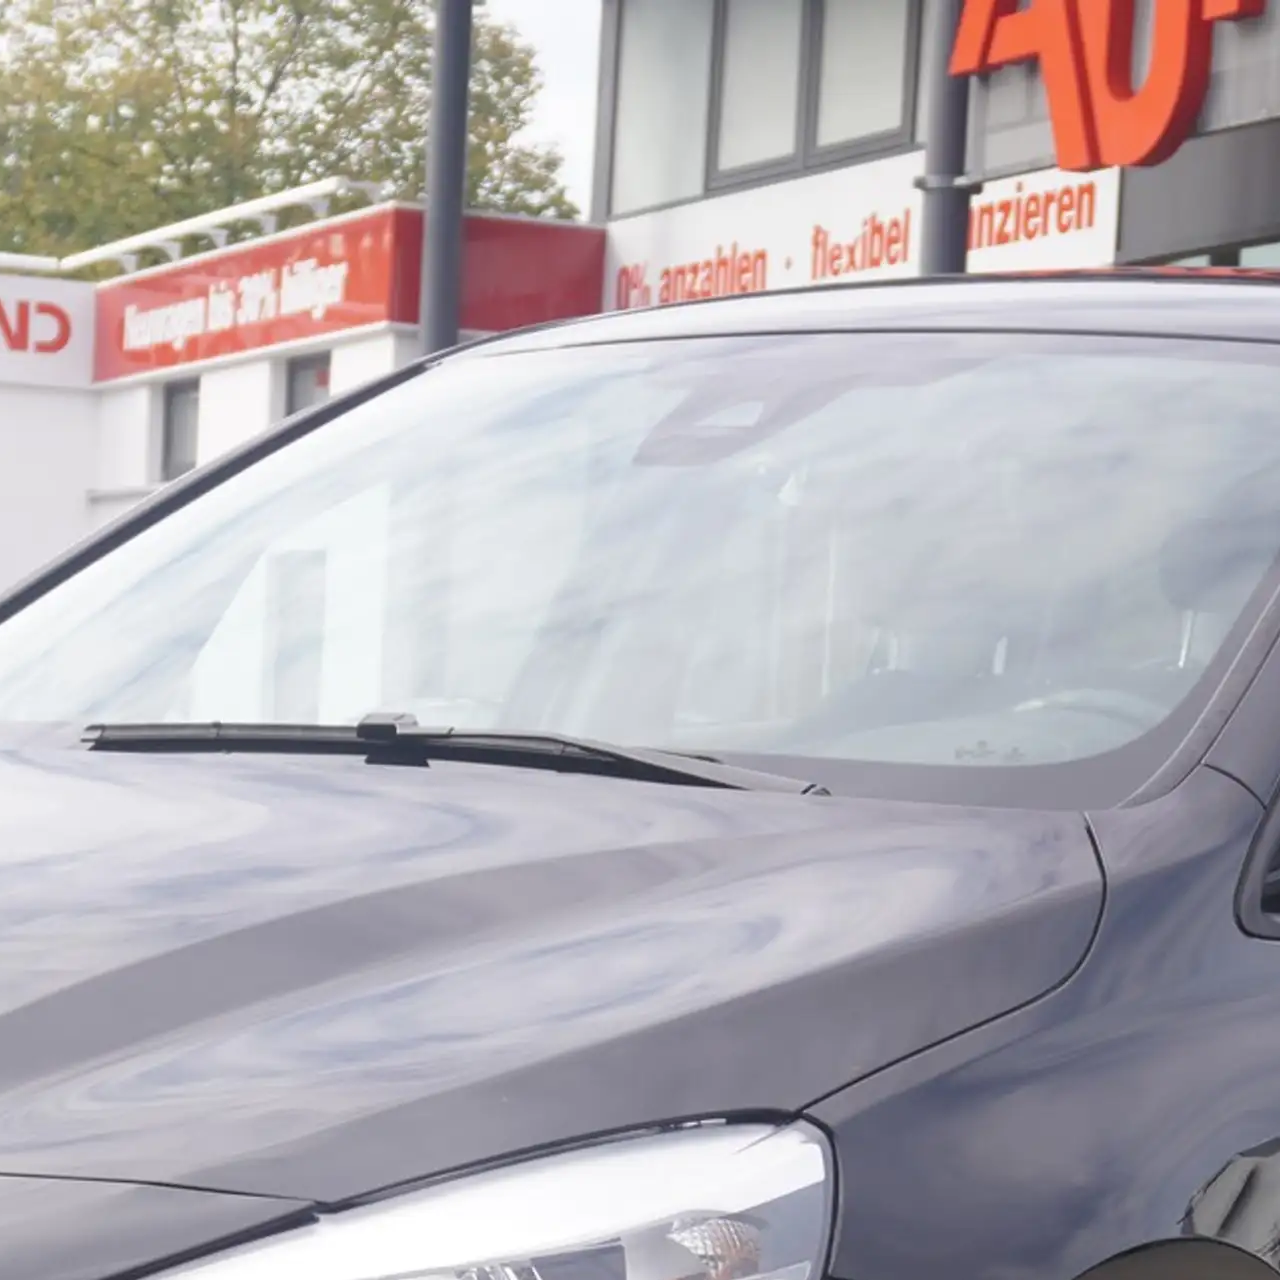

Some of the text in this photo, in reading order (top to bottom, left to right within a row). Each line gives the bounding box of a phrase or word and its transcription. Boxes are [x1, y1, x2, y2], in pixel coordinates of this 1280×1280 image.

[659, 241, 768, 304] anzahlen
[811, 208, 911, 280] flexibel
[967, 181, 1097, 251] nzieren
